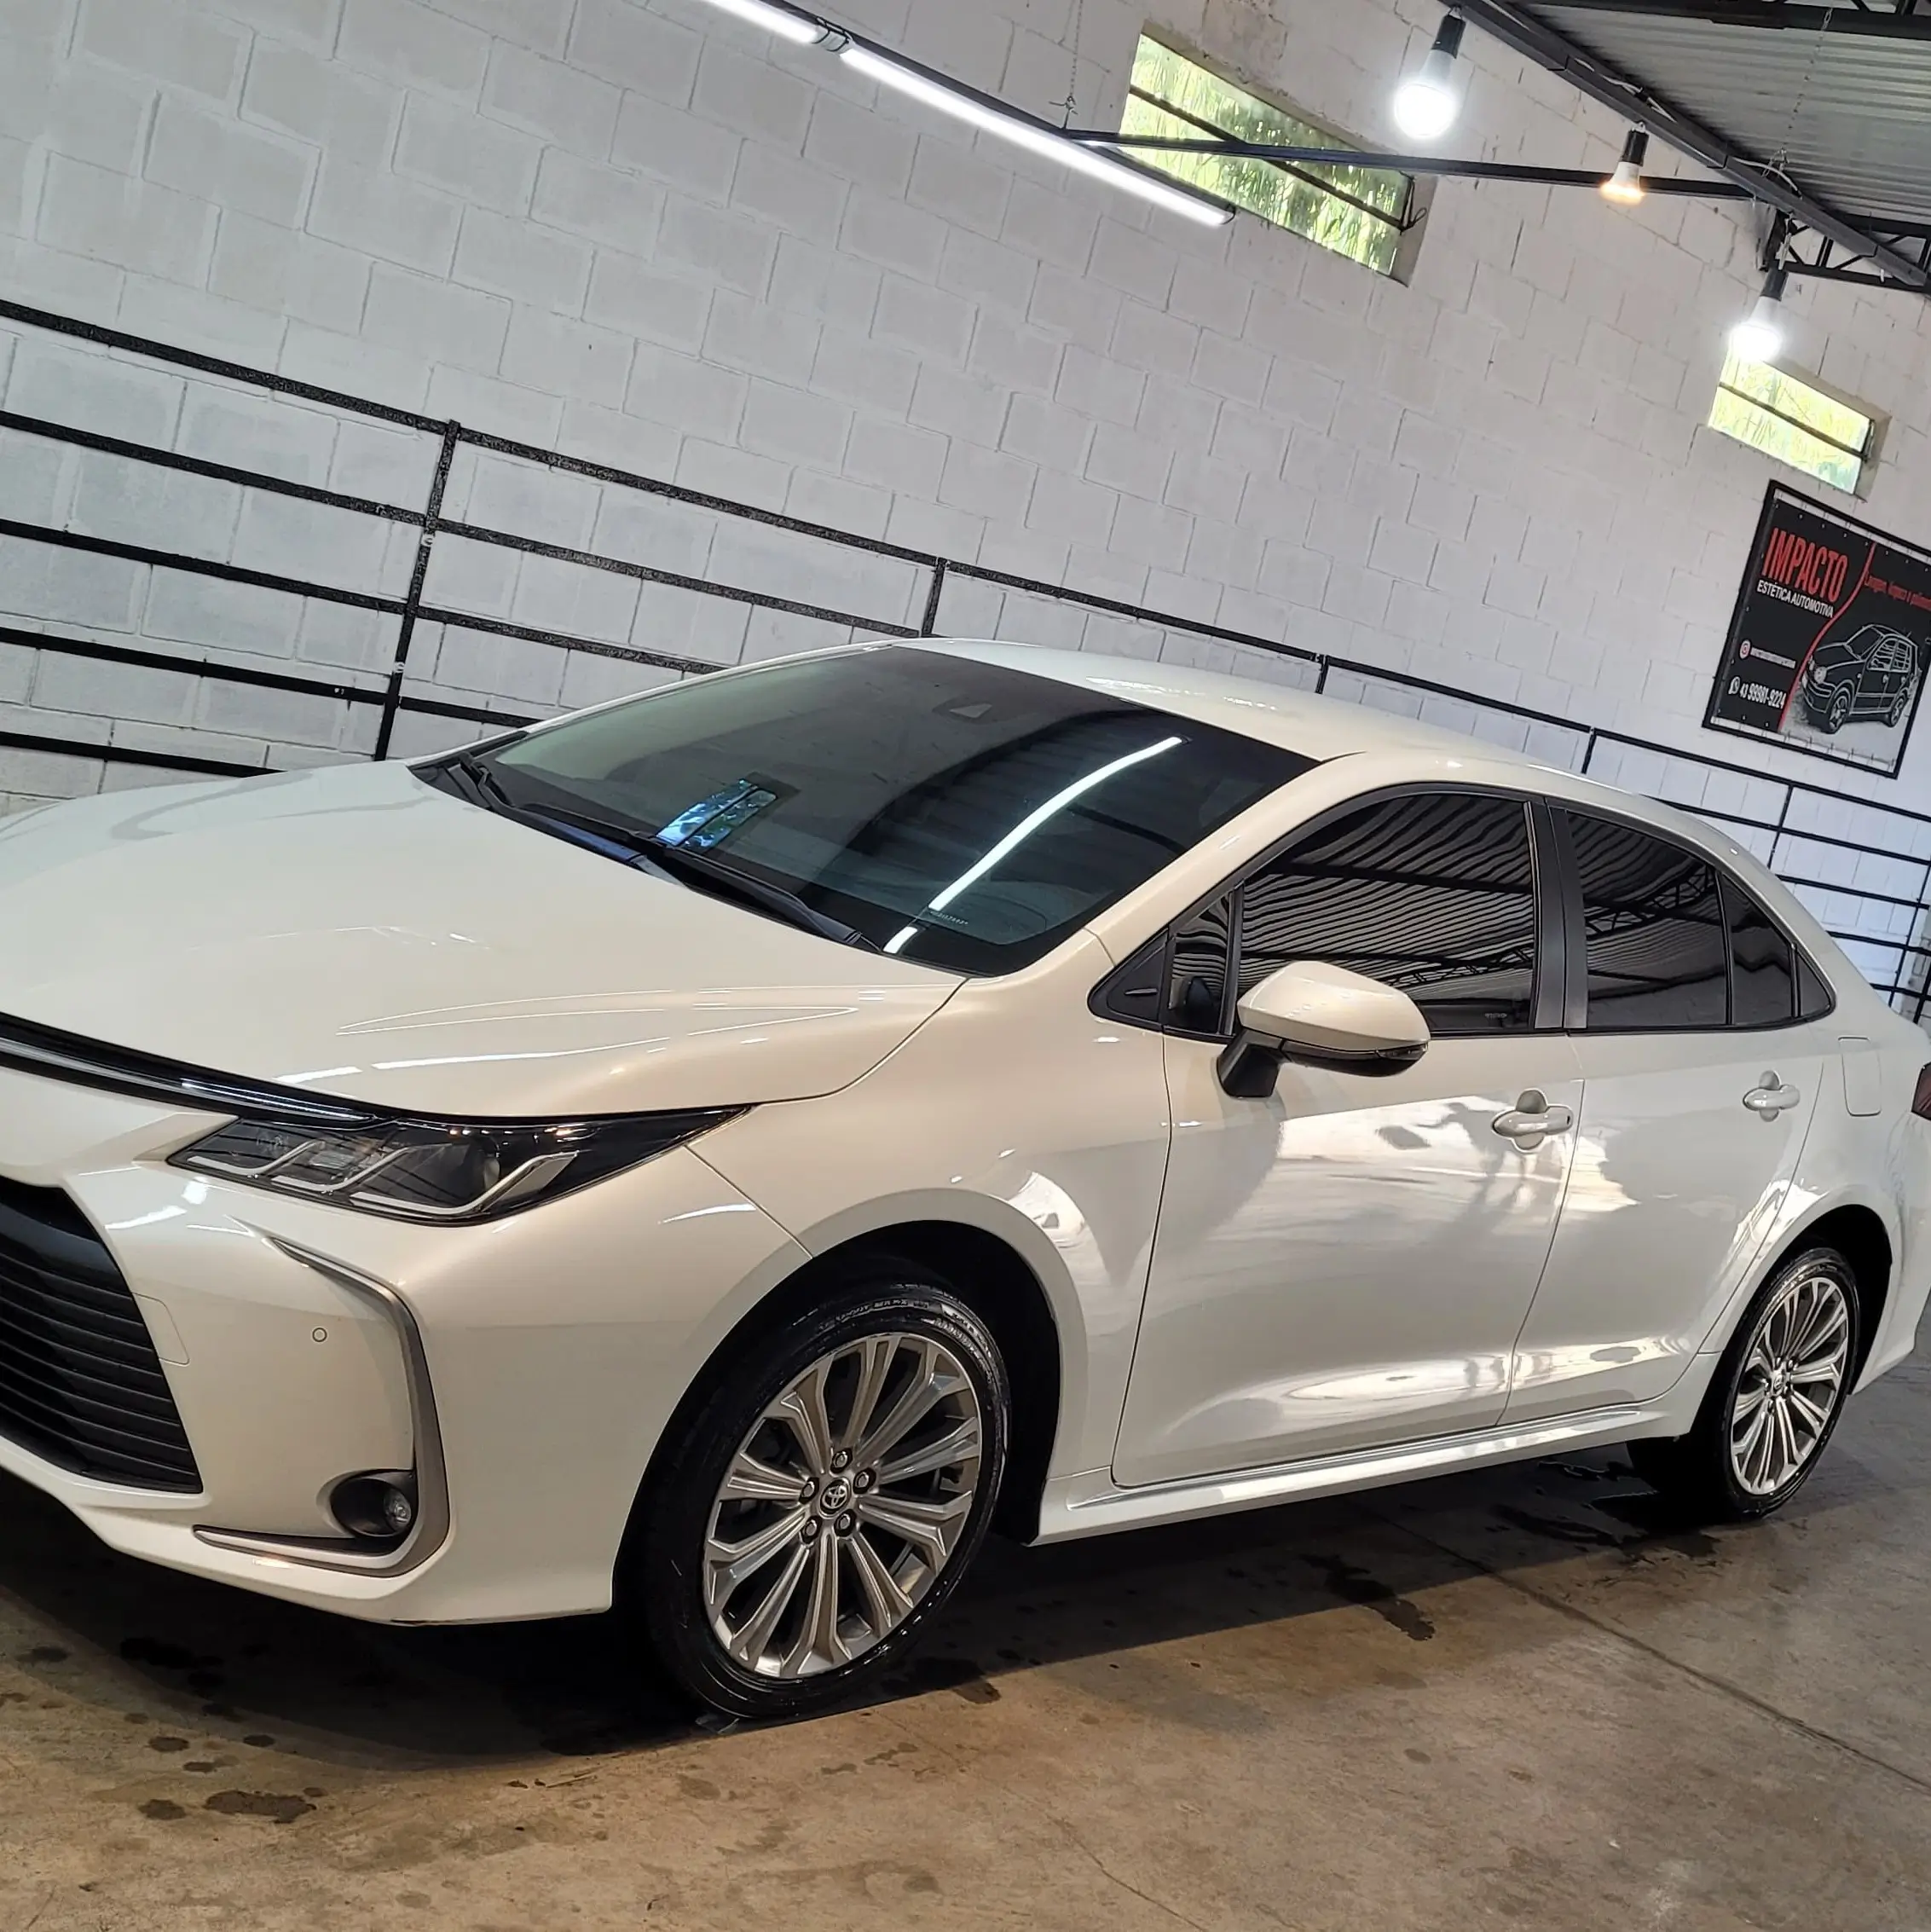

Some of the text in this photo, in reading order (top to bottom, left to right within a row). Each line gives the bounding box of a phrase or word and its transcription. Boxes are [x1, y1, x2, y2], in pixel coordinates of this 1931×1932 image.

[1761, 527, 1848, 603] IMPACTO
[1756, 580, 1834, 618] ESTÉTICA AUTOMOTIVA
